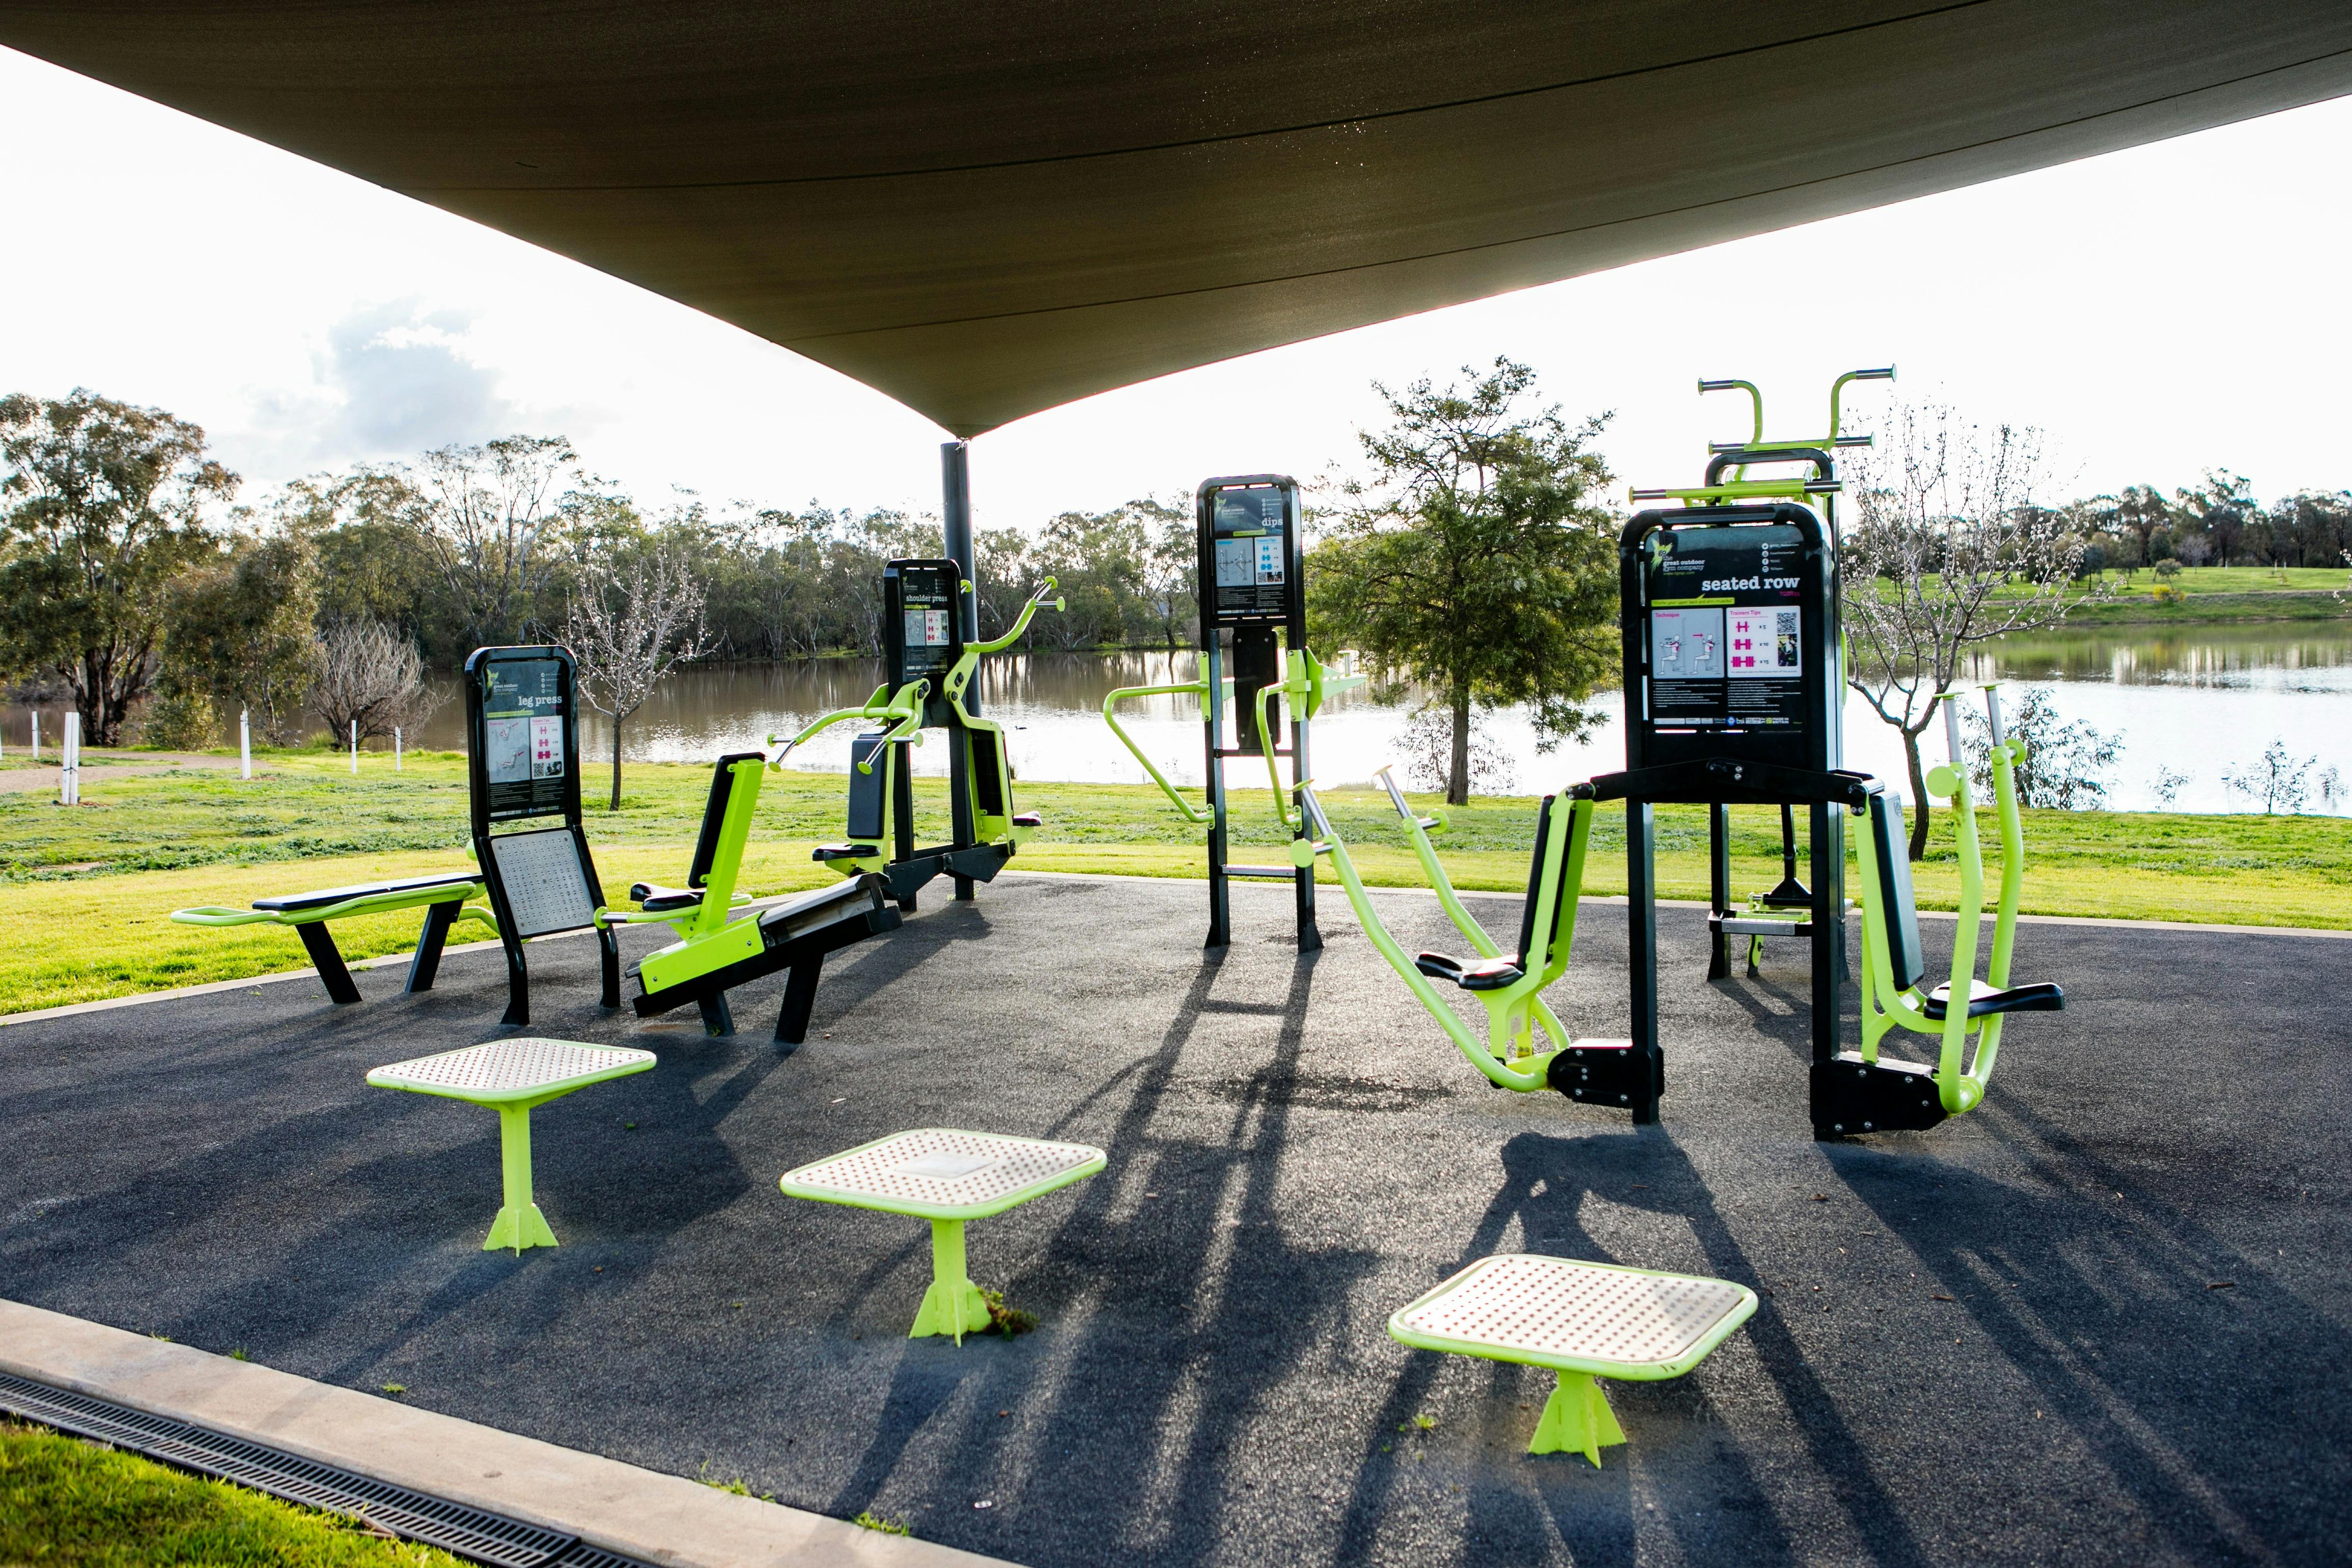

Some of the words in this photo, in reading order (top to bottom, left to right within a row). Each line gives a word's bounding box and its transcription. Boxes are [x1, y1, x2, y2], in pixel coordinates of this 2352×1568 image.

[1262, 517, 1283, 527] dips
[1702, 576, 1760, 591] seated
[1763, 577, 1800, 589] row
[518, 696, 534, 708] leg
[535, 696, 562, 707] press
